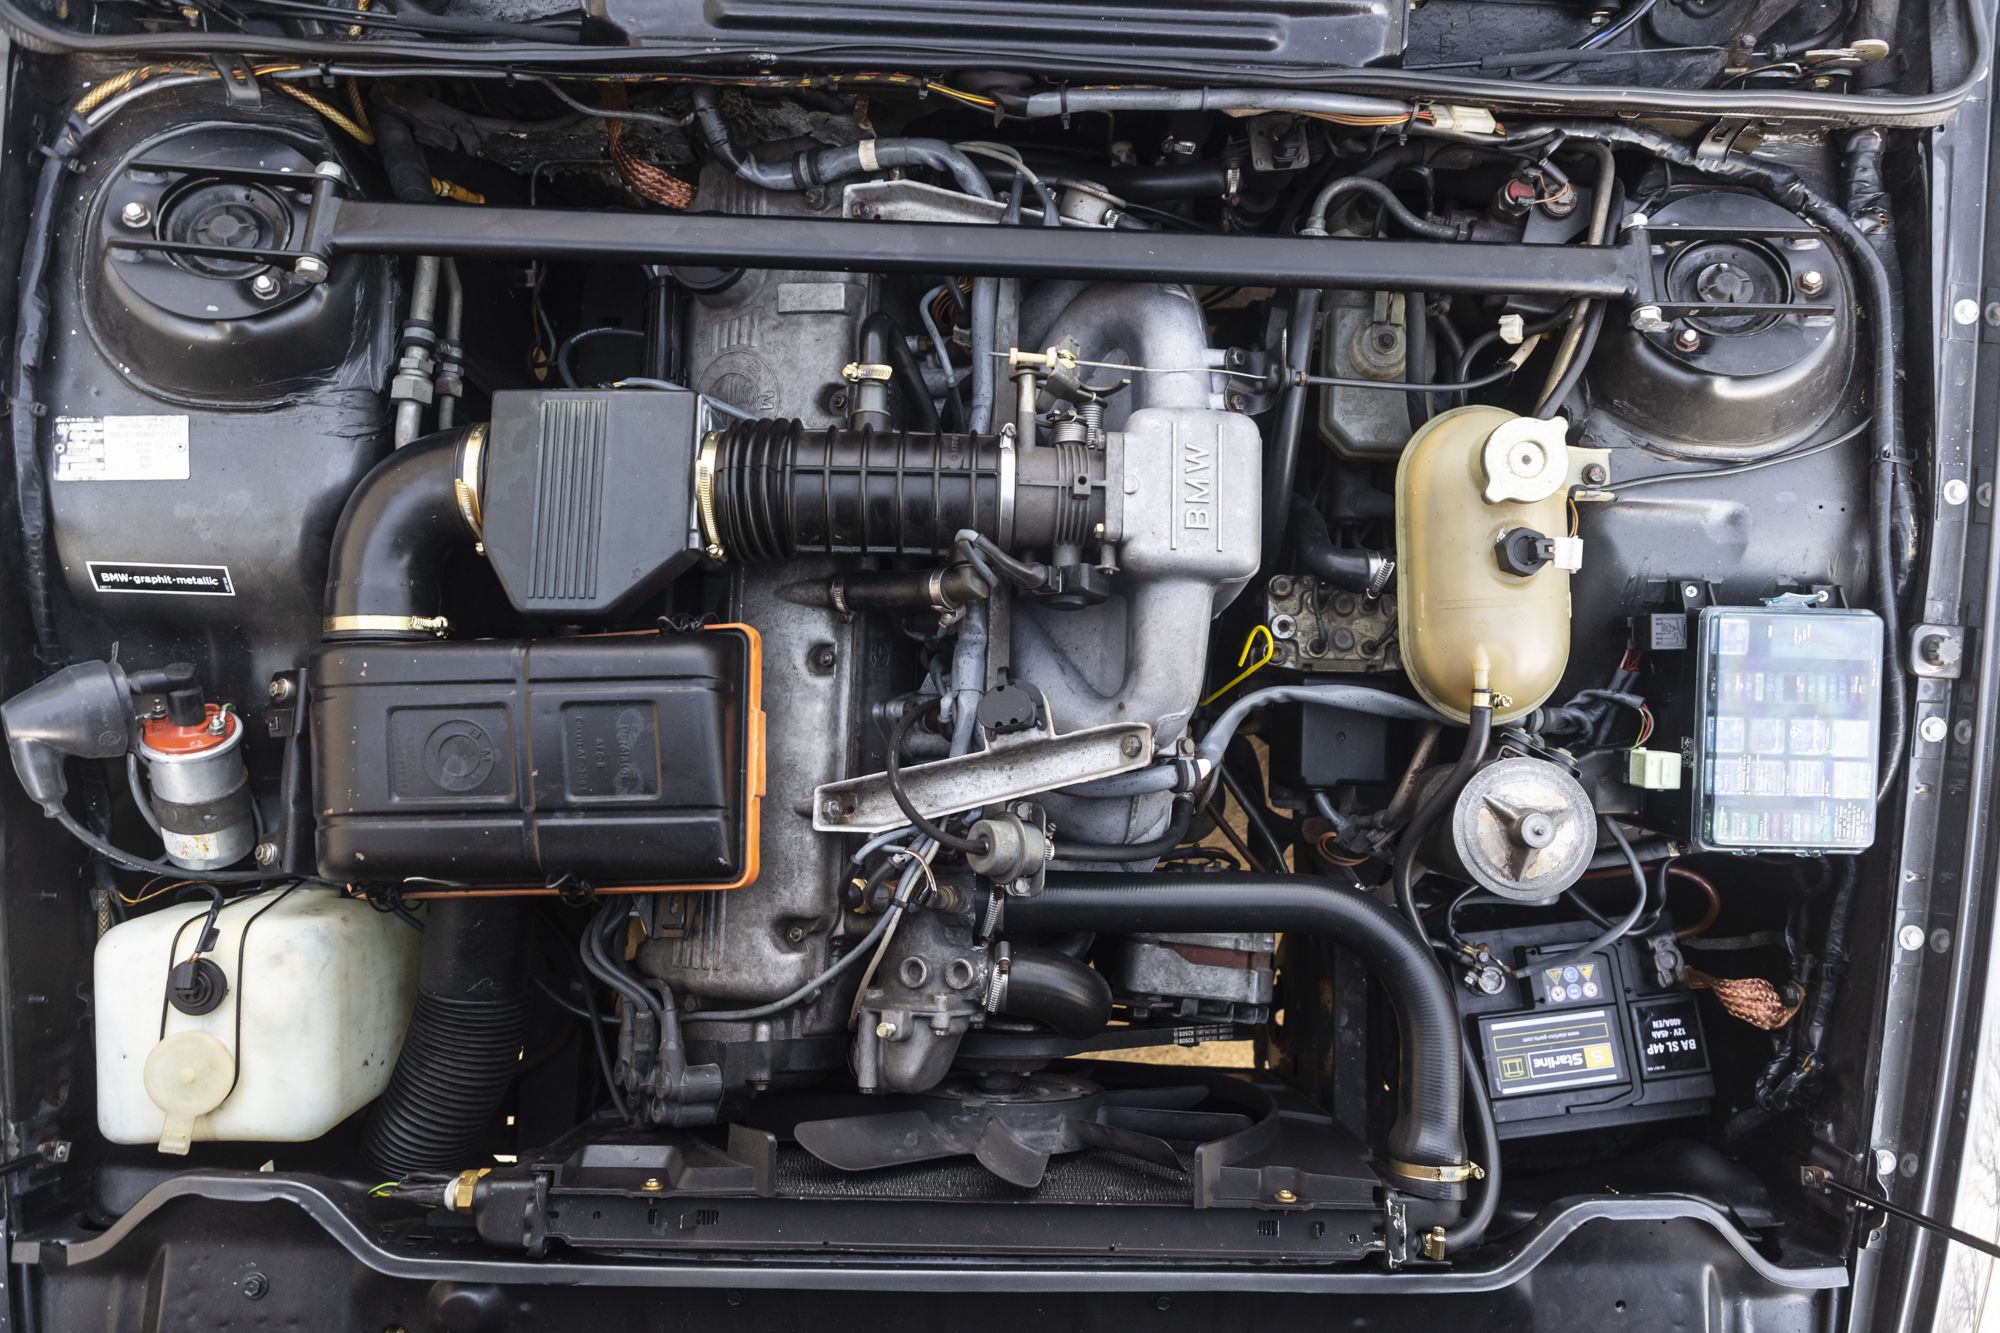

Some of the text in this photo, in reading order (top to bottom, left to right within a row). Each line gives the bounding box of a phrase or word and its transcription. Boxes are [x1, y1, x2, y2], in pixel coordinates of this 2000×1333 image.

[1184, 442, 1210, 530] BMW
[100, 572, 220, 586] BMW-graphit-metallic
[1673, 1027, 1687, 1037] 12V
[1646, 1038, 1697, 1055] BA SL 44P
[1532, 1052, 1584, 1069] Starline
